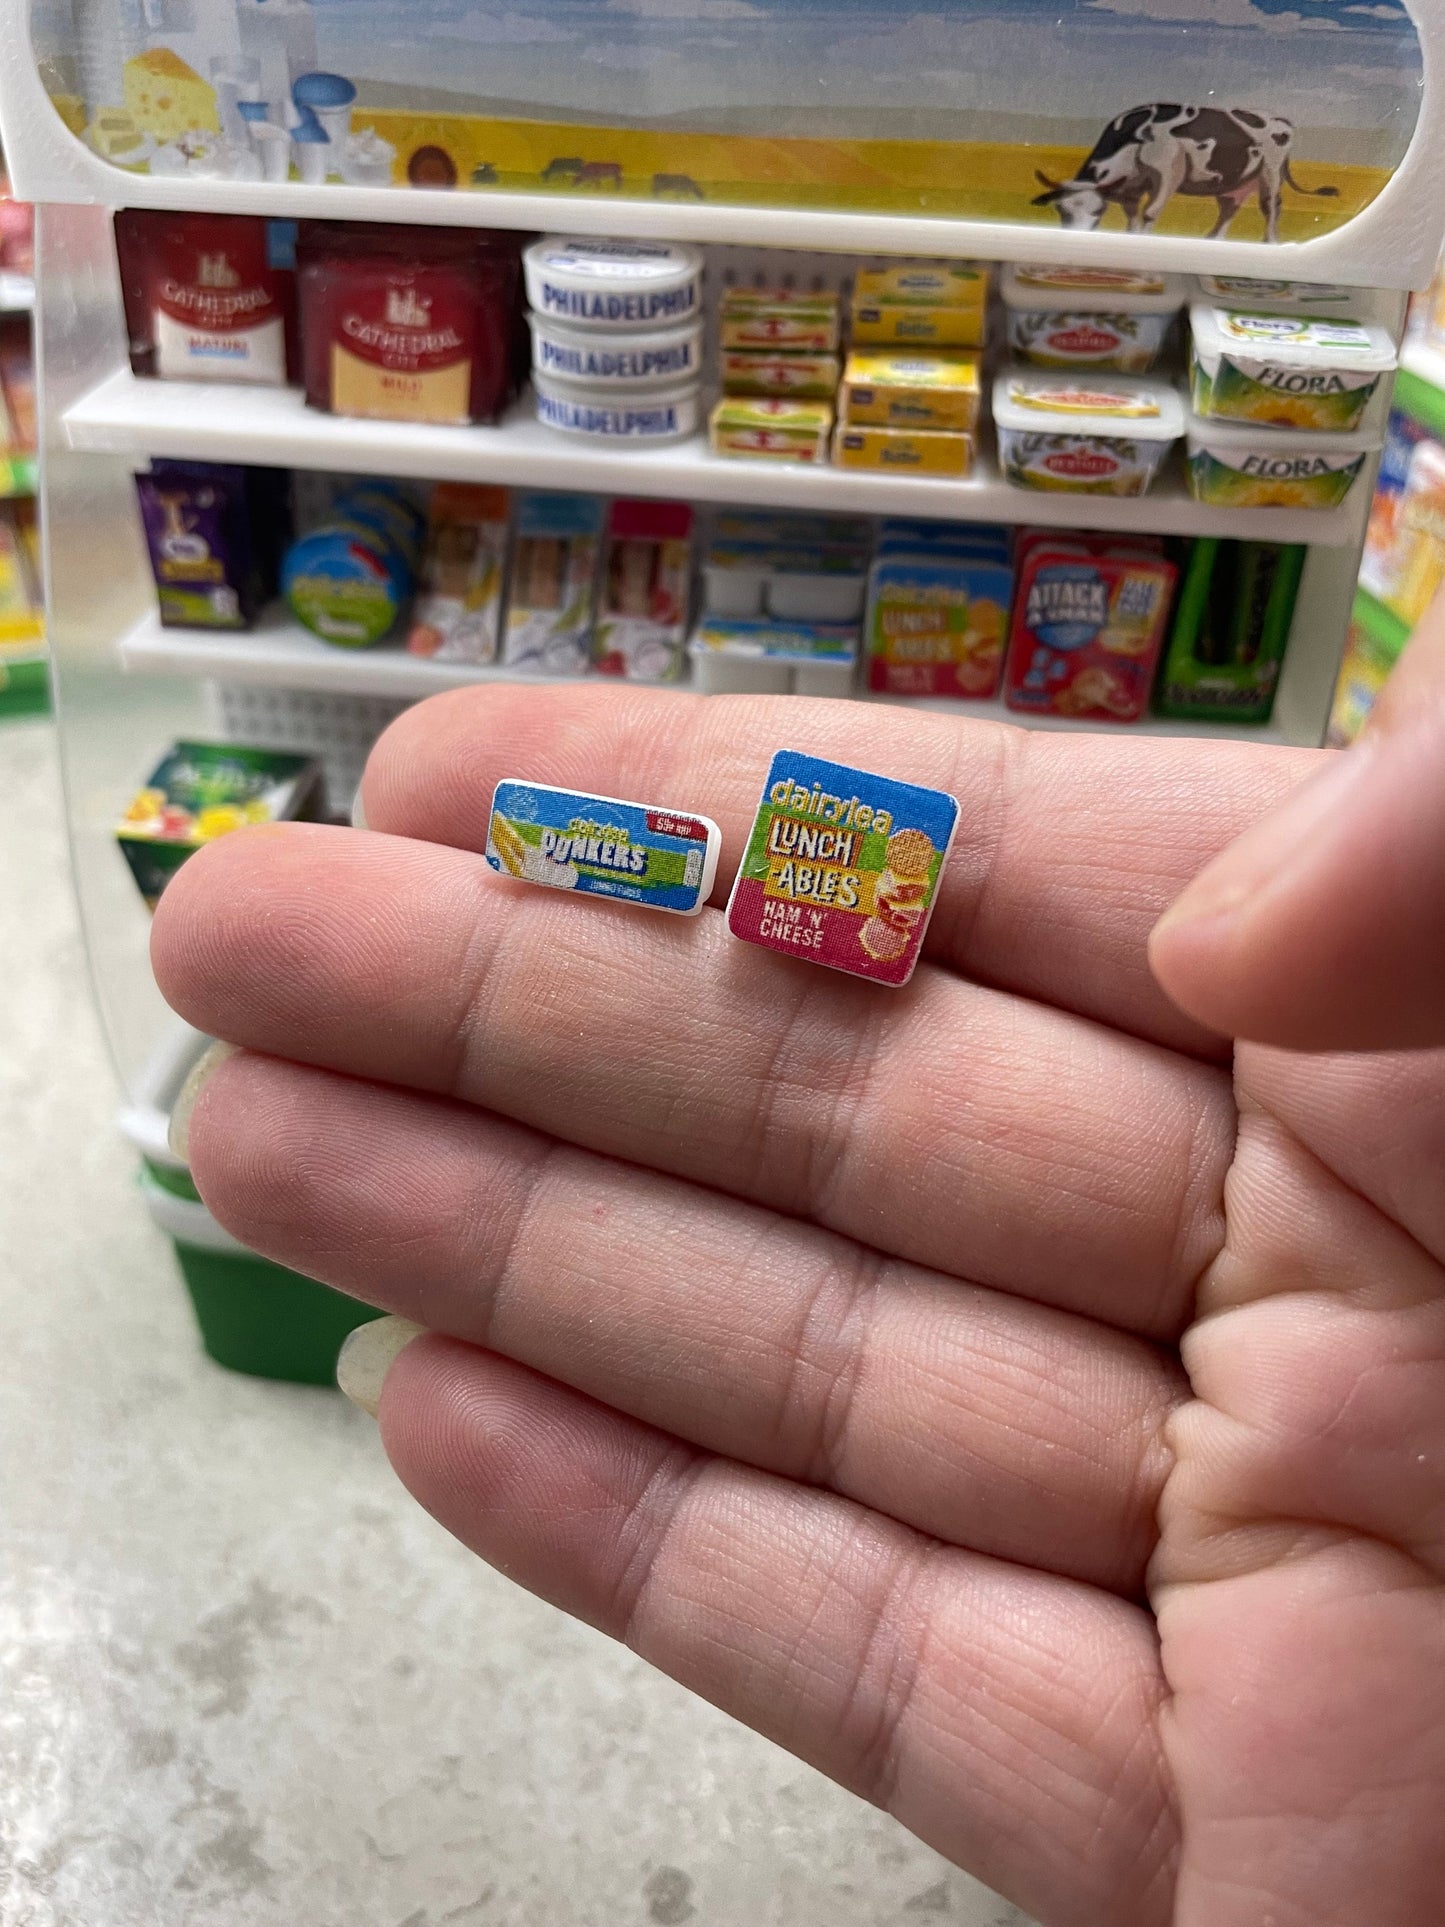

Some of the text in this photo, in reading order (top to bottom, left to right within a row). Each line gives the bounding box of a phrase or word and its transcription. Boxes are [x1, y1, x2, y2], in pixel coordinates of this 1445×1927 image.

[543, 281, 694, 321] PHILADELPHIA
[342, 315, 462, 355] CATHEDRAL
[542, 341, 689, 377] PHILADELPHIA
[1257, 366, 1346, 394] FLORA
[537, 391, 676, 434] PHILADELPHIA
[1241, 456, 1332, 479] FLORA
[769, 777, 894, 836] dairylea
[541, 828, 649, 873] DUNKERS
[767, 818, 859, 867] LUNCH
[762, 901, 801, 924] HAM
[759, 918, 825, 949] CHEESE
